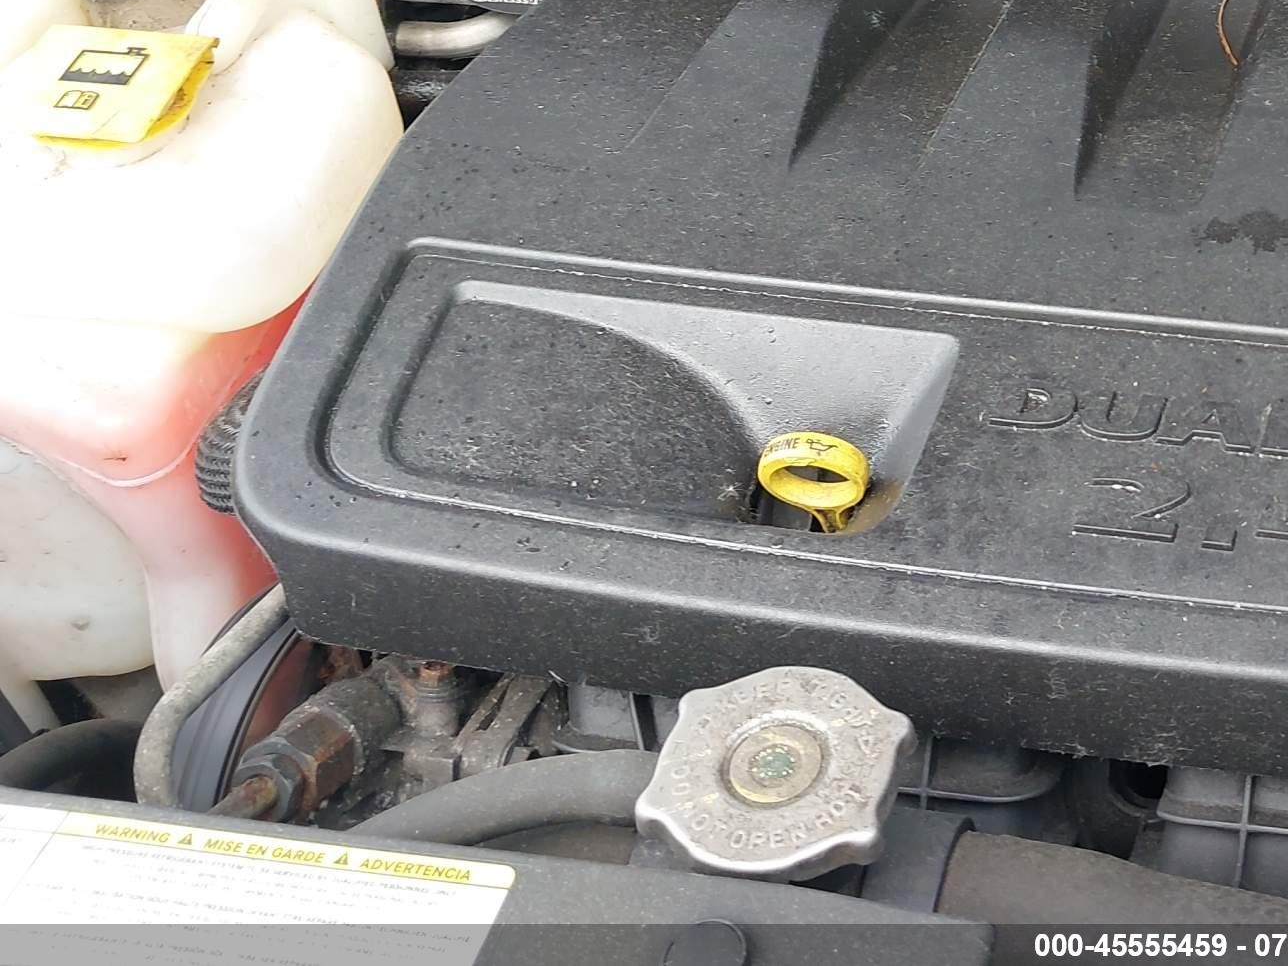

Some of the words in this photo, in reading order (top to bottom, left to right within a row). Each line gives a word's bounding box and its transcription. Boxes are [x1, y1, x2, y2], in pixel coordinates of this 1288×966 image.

[95, 824, 171, 843] WARNING
[203, 837, 245, 854] MISE
[245, 843, 269, 856] EN
[271, 846, 326, 864] GARDE
[359, 858, 472, 881] ADVERTENCIA
[730, 825, 807, 850] OPEN
